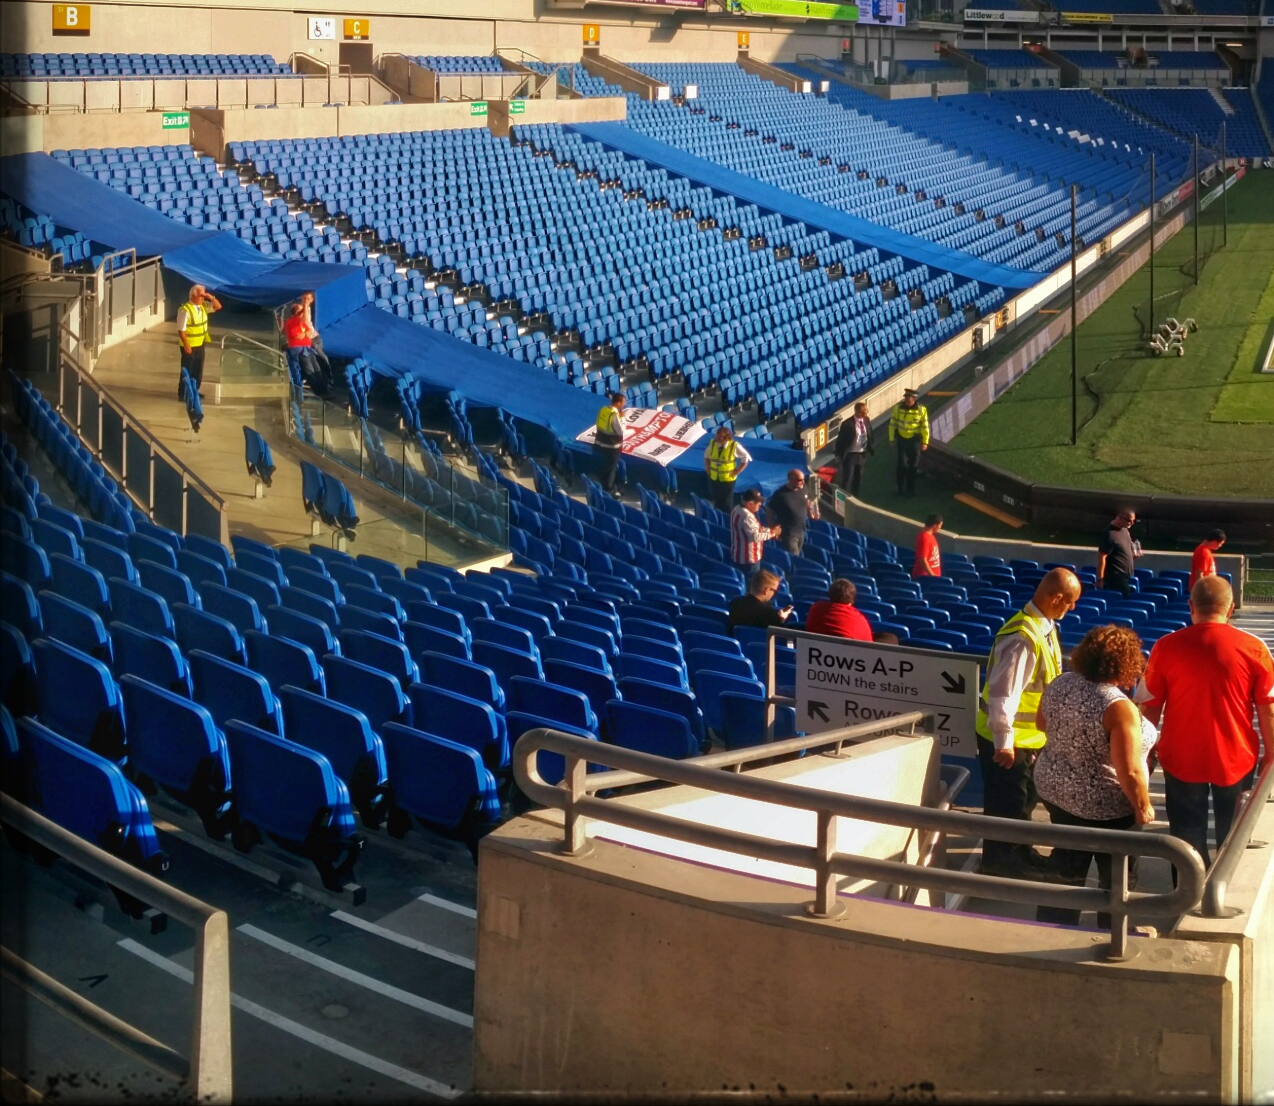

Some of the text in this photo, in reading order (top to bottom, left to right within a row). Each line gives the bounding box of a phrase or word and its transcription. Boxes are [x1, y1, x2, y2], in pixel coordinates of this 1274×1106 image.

[66, 6, 78, 26] B
[353, 21, 360, 34] C
[589, 27, 595, 38] D
[741, 33, 746, 43] E
[163, 116, 177, 125] Exit
[819, 428, 825, 446] B
[808, 647, 914, 678] Rows A-P
[807, 669, 918, 696] DOWN the stairs
[162, 861, 169, 870] U
